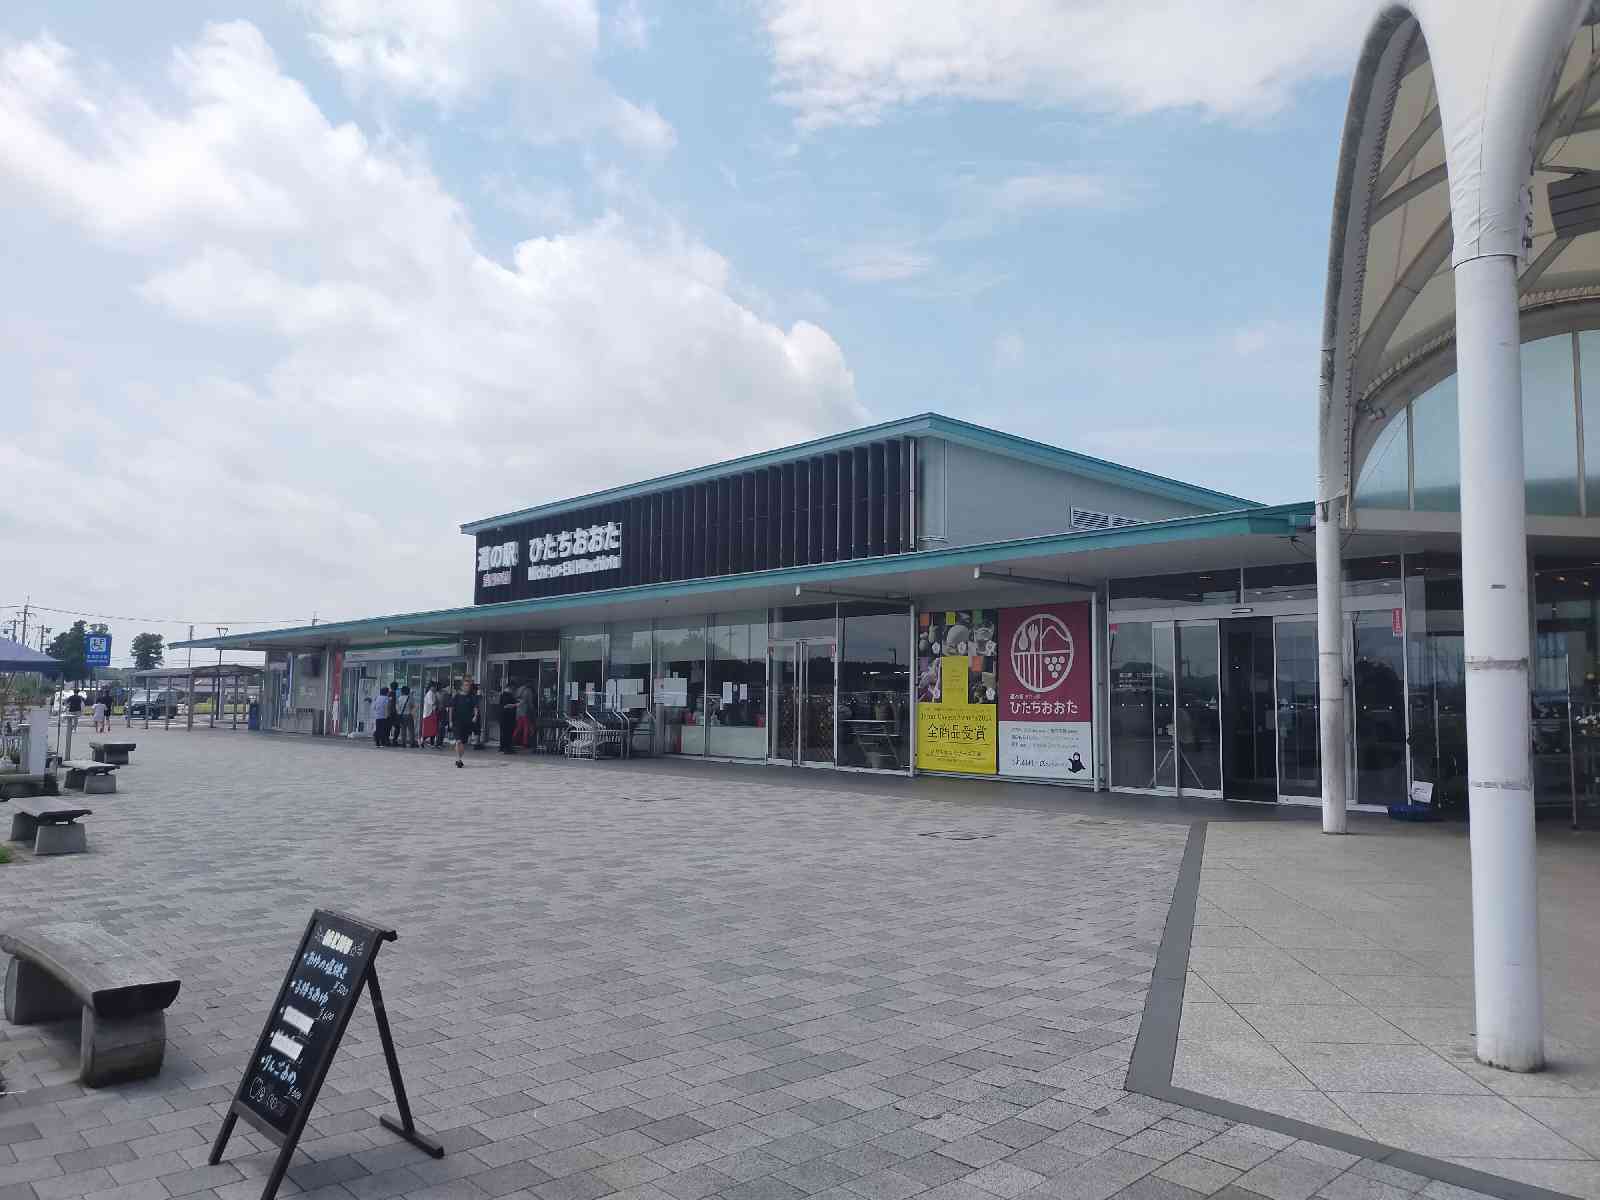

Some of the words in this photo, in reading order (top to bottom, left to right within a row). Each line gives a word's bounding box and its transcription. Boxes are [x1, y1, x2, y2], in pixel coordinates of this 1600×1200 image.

[528, 521, 620, 562] ひたちおおた
[1009, 699, 1079, 714] ひたちおおた
